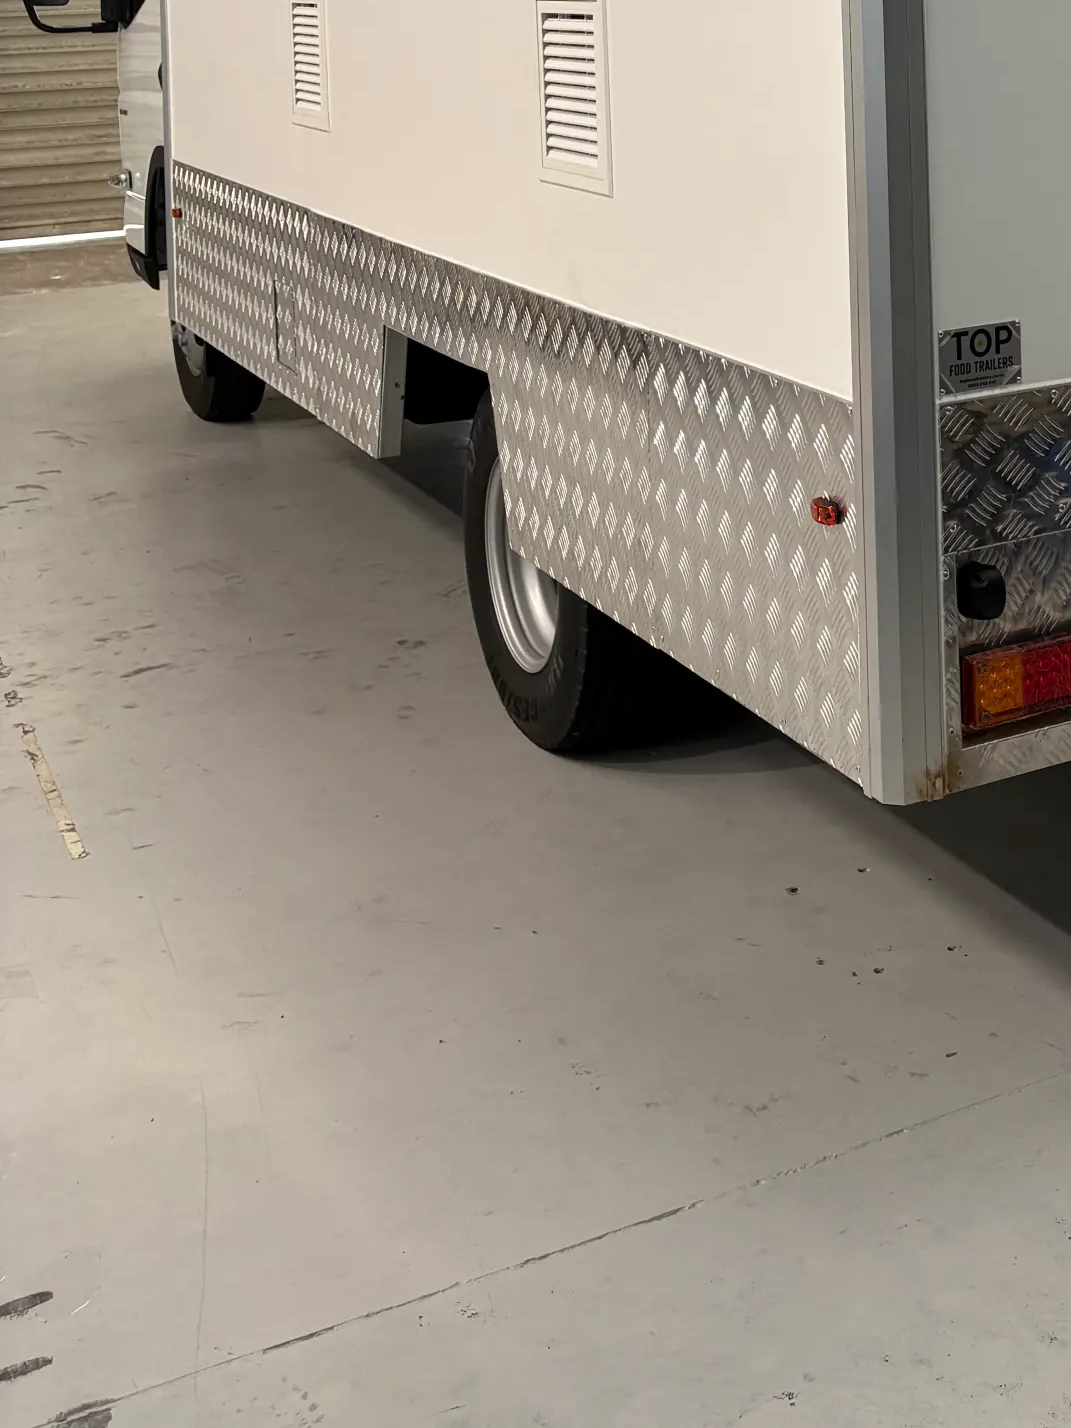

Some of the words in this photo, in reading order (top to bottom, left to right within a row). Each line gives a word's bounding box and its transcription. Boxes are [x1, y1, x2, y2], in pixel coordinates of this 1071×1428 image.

[951, 325, 1013, 360] TOP
[949, 362, 972, 377] FOOD
[973, 356, 1014, 373] TRAILERS
